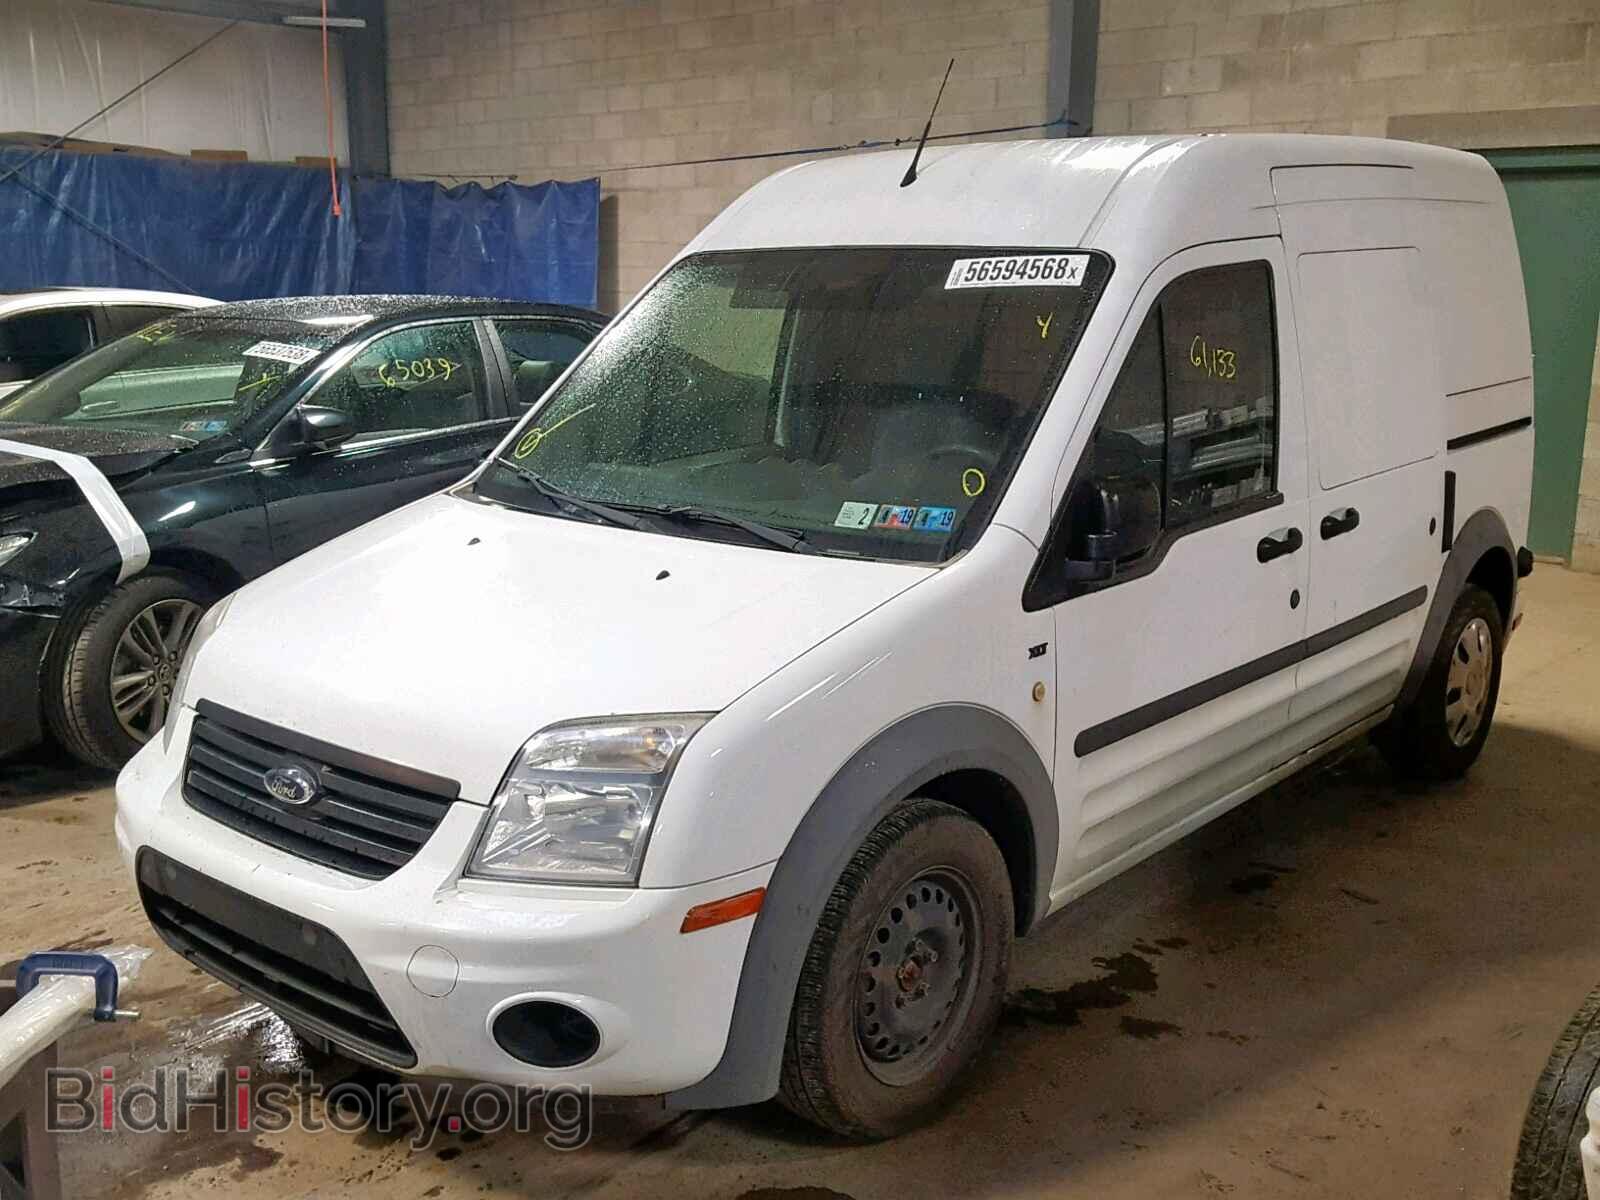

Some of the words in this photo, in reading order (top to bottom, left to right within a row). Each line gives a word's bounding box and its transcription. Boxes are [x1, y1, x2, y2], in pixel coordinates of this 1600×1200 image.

[857, 507, 870, 526] 2
[900, 508, 913, 524] 19
[941, 510, 954, 526] 19
[271, 775, 297, 798] Ford
